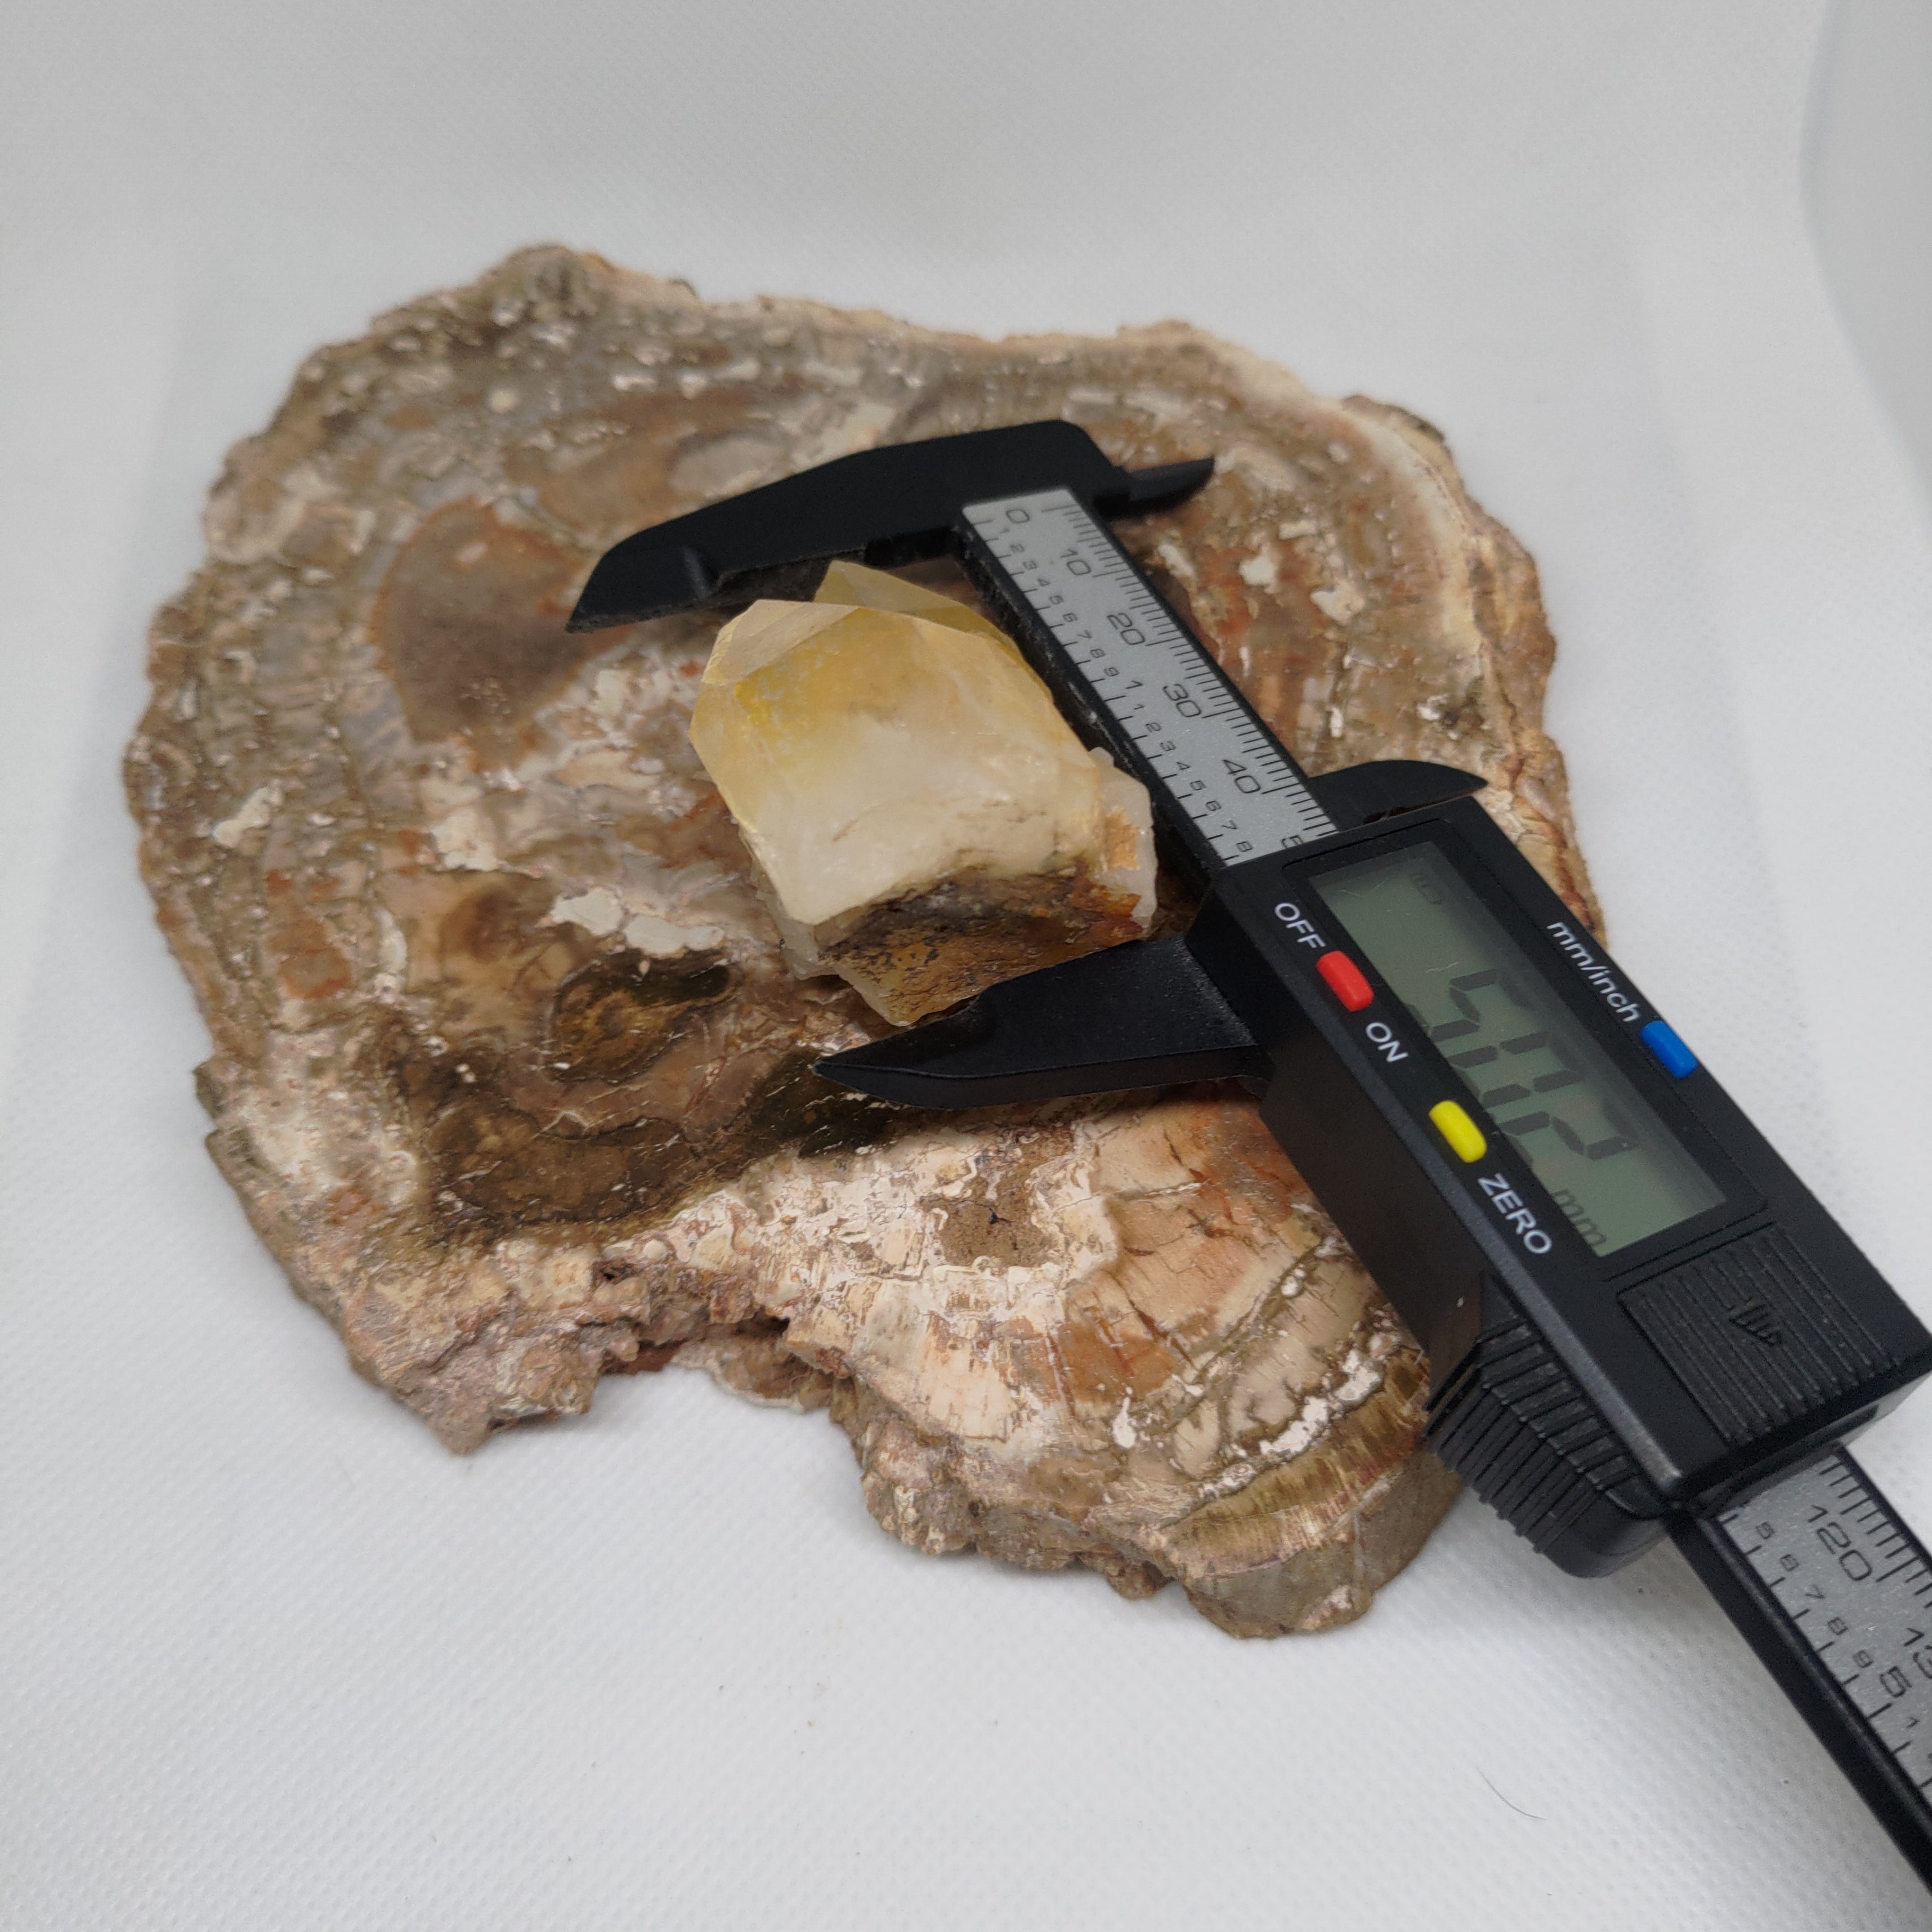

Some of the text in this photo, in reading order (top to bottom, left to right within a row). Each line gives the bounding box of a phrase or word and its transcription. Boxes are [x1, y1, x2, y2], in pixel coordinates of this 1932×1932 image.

[1006, 508, 1030, 524] 0
[1061, 548, 1092, 576] 10
[1107, 612, 1146, 645] 20
[1162, 683, 1202, 718] 30
[1222, 759, 1261, 794] 40
[1009, 543, 1025, 553] 2
[1022, 560, 1037, 570] 3
[1036, 578, 1051, 587] 4
[1049, 594, 1065, 605] 5
[1062, 612, 1078, 623] 6
[1076, 629, 1092, 639] 7
[1089, 649, 1106, 658] 8
[1103, 667, 1120, 677] 9
[1125, 679, 1143, 689] 1
[1144, 722, 1162, 732] 2
[1159, 741, 1176, 752] 3
[1176, 761, 1191, 770] 4
[1189, 780, 1206, 791] 5
[1205, 800, 1222, 811] 6
[1221, 819, 1238, 830] 7
[1236, 840, 1253, 852] 8
[1274, 902, 1408, 1063] OFF ON
[1546, 922, 1640, 1022] mm/inch
[1477, 1172, 1553, 1254] ZERO
[1808, 1504, 1872, 1581] 120
[1804, 1584, 1825, 1599] 7
[1879, 1665, 1913, 1698] 5
